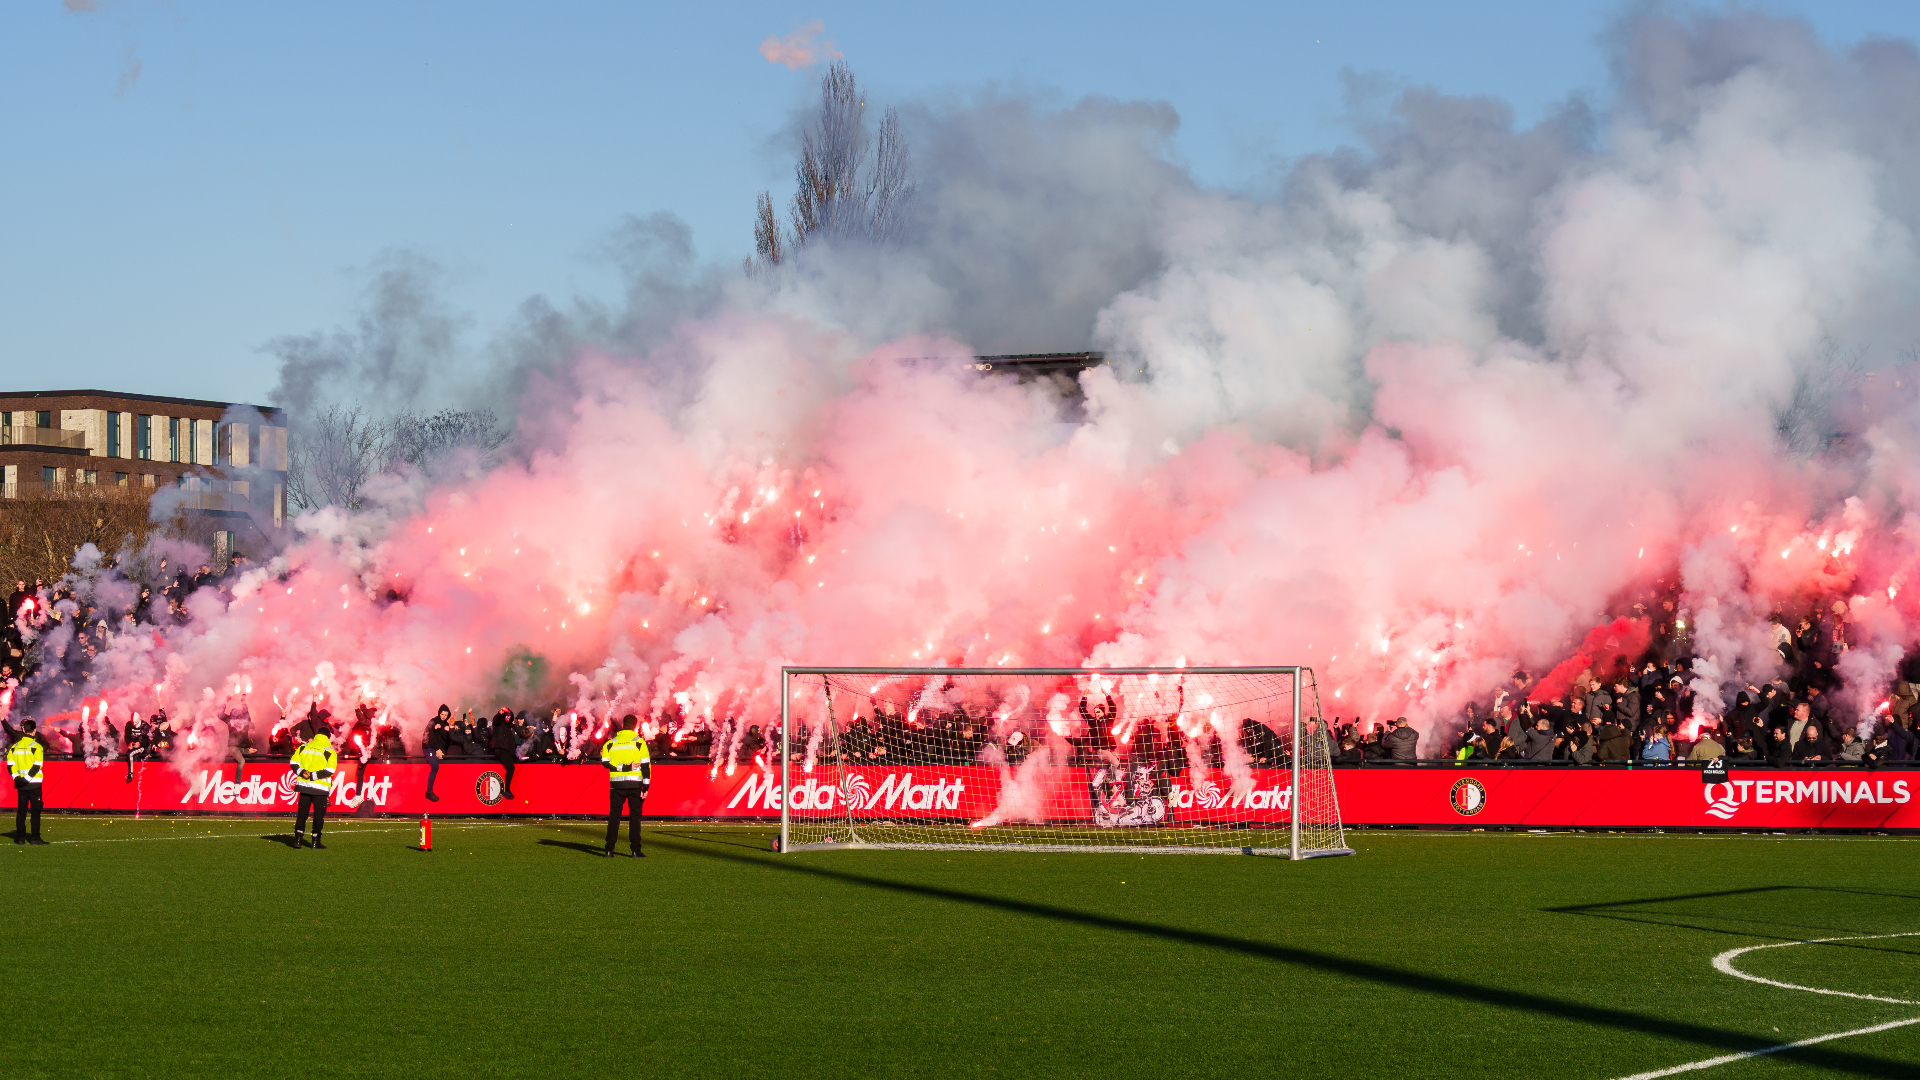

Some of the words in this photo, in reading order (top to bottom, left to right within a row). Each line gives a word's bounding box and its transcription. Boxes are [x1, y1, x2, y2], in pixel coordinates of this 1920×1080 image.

[181, 769, 278, 805] Media
[727, 773, 836, 810] Media
[863, 772, 965, 810] Markt
[1216, 784, 1293, 810] Markt
